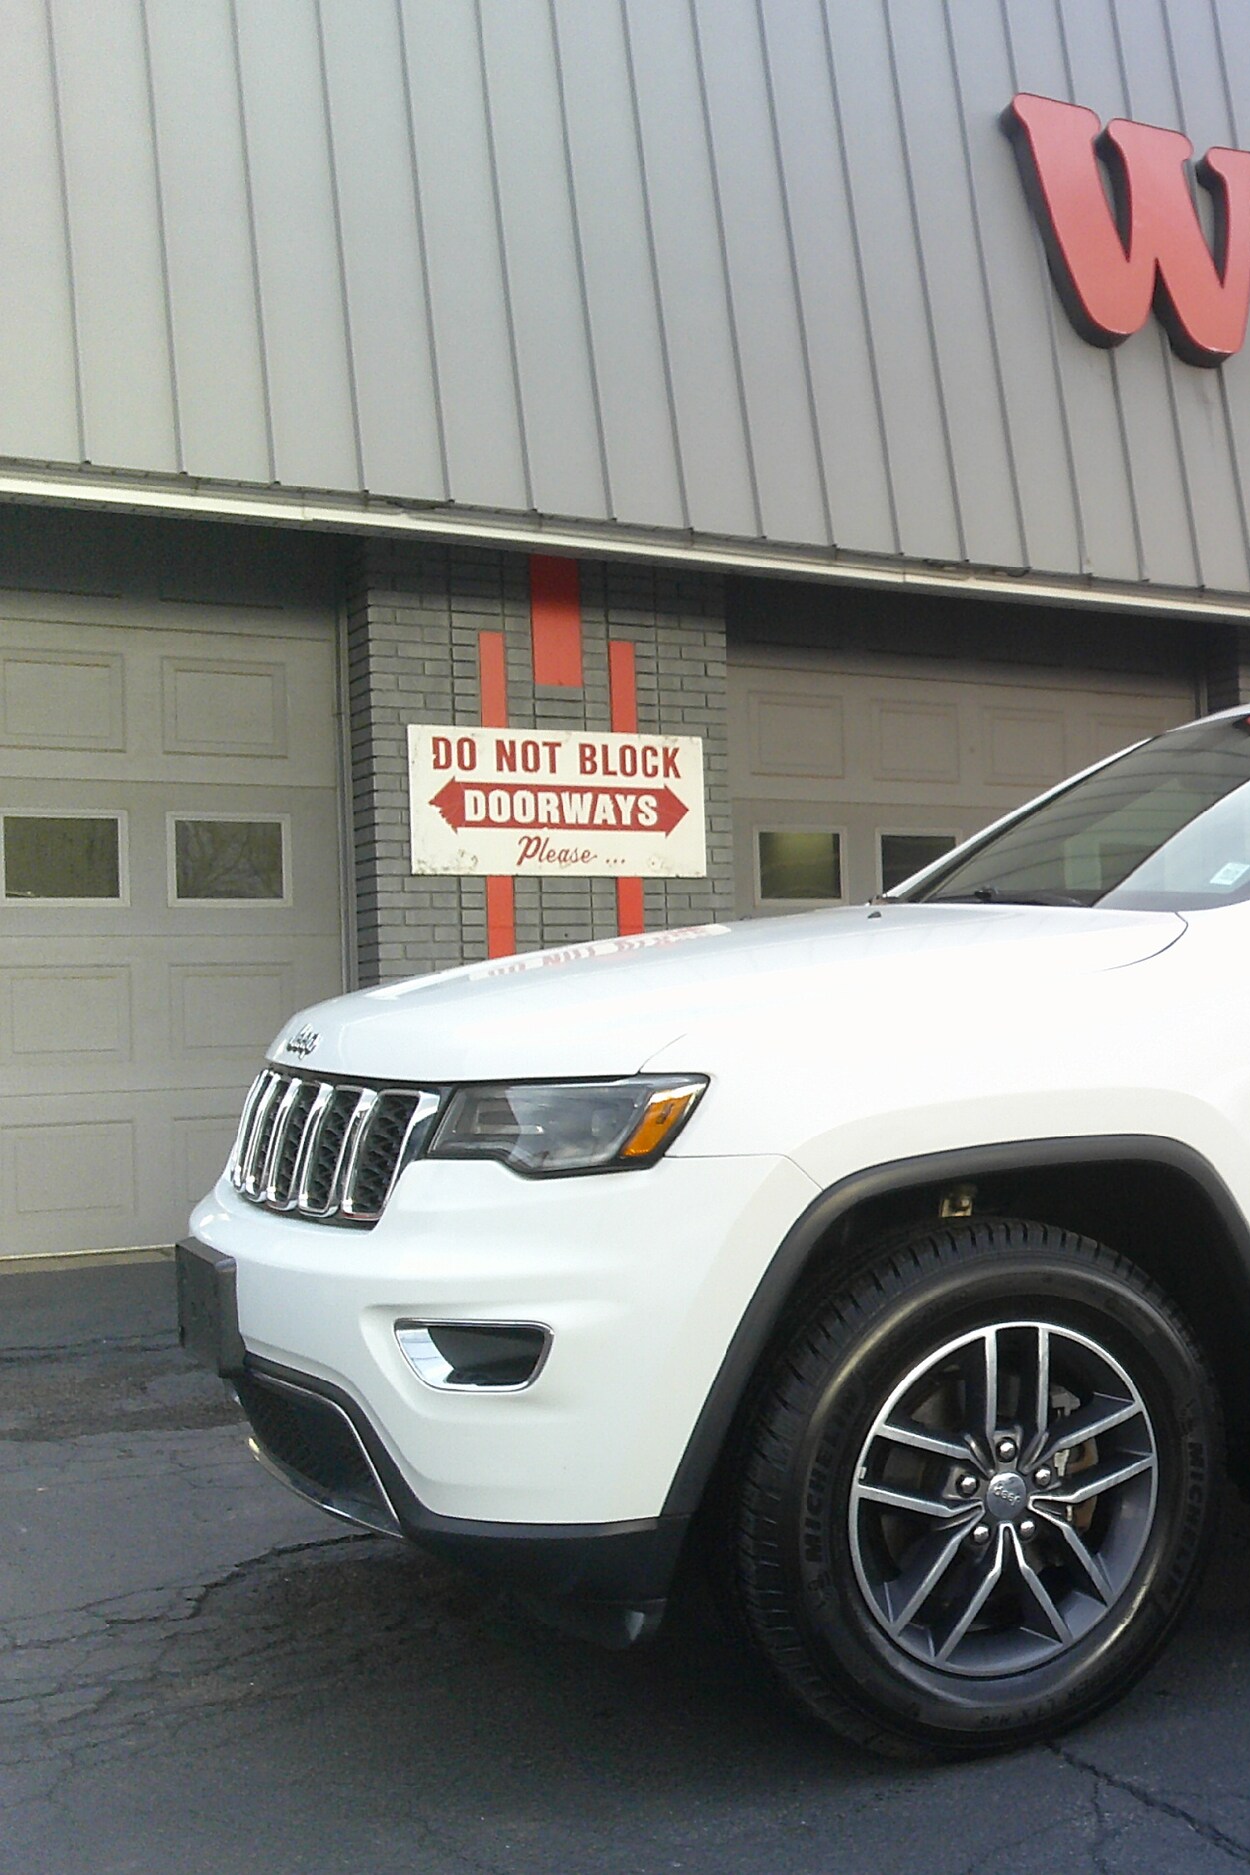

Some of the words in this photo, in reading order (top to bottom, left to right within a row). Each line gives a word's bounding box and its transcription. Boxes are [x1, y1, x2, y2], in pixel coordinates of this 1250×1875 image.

[432, 736, 477, 771] DO
[496, 739, 562, 774] NOT
[579, 743, 682, 779] BLOCK
[464, 789, 658, 826] DOORWAYS
